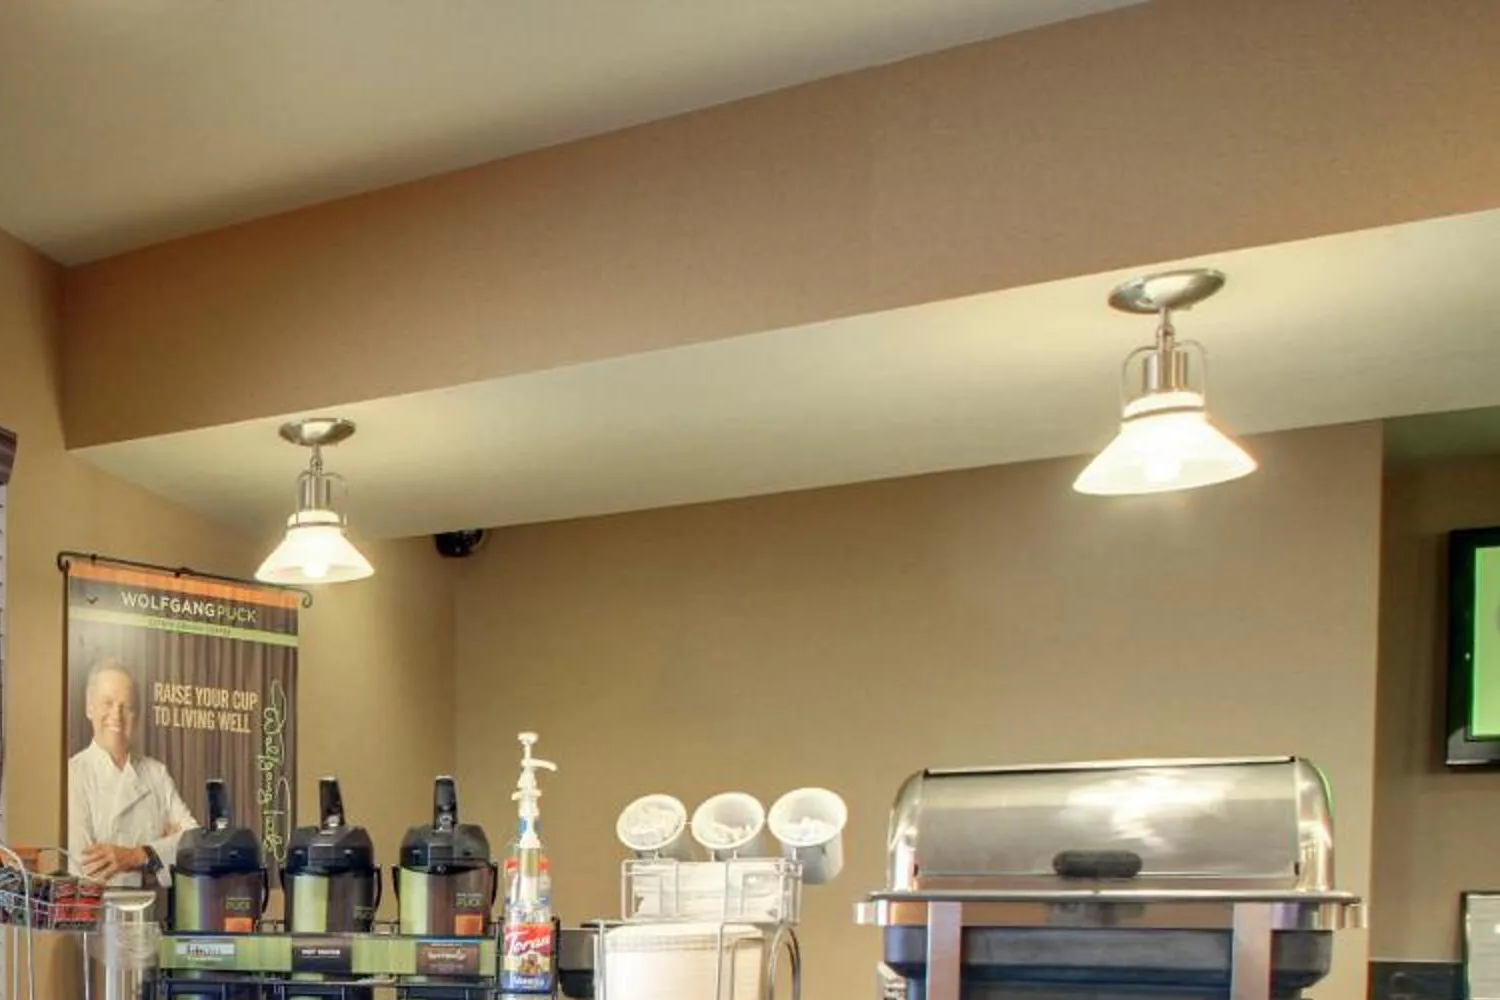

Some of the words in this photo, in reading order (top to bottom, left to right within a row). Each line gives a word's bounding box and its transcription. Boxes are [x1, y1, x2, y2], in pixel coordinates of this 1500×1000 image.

[154, 682, 192, 705] RAISE
[195, 687, 229, 710] YOUR
[232, 690, 259, 711] CUP
[153, 705, 171, 727] TO
[173, 706, 215, 731] LIVING
[218, 711, 252, 734] WELL
